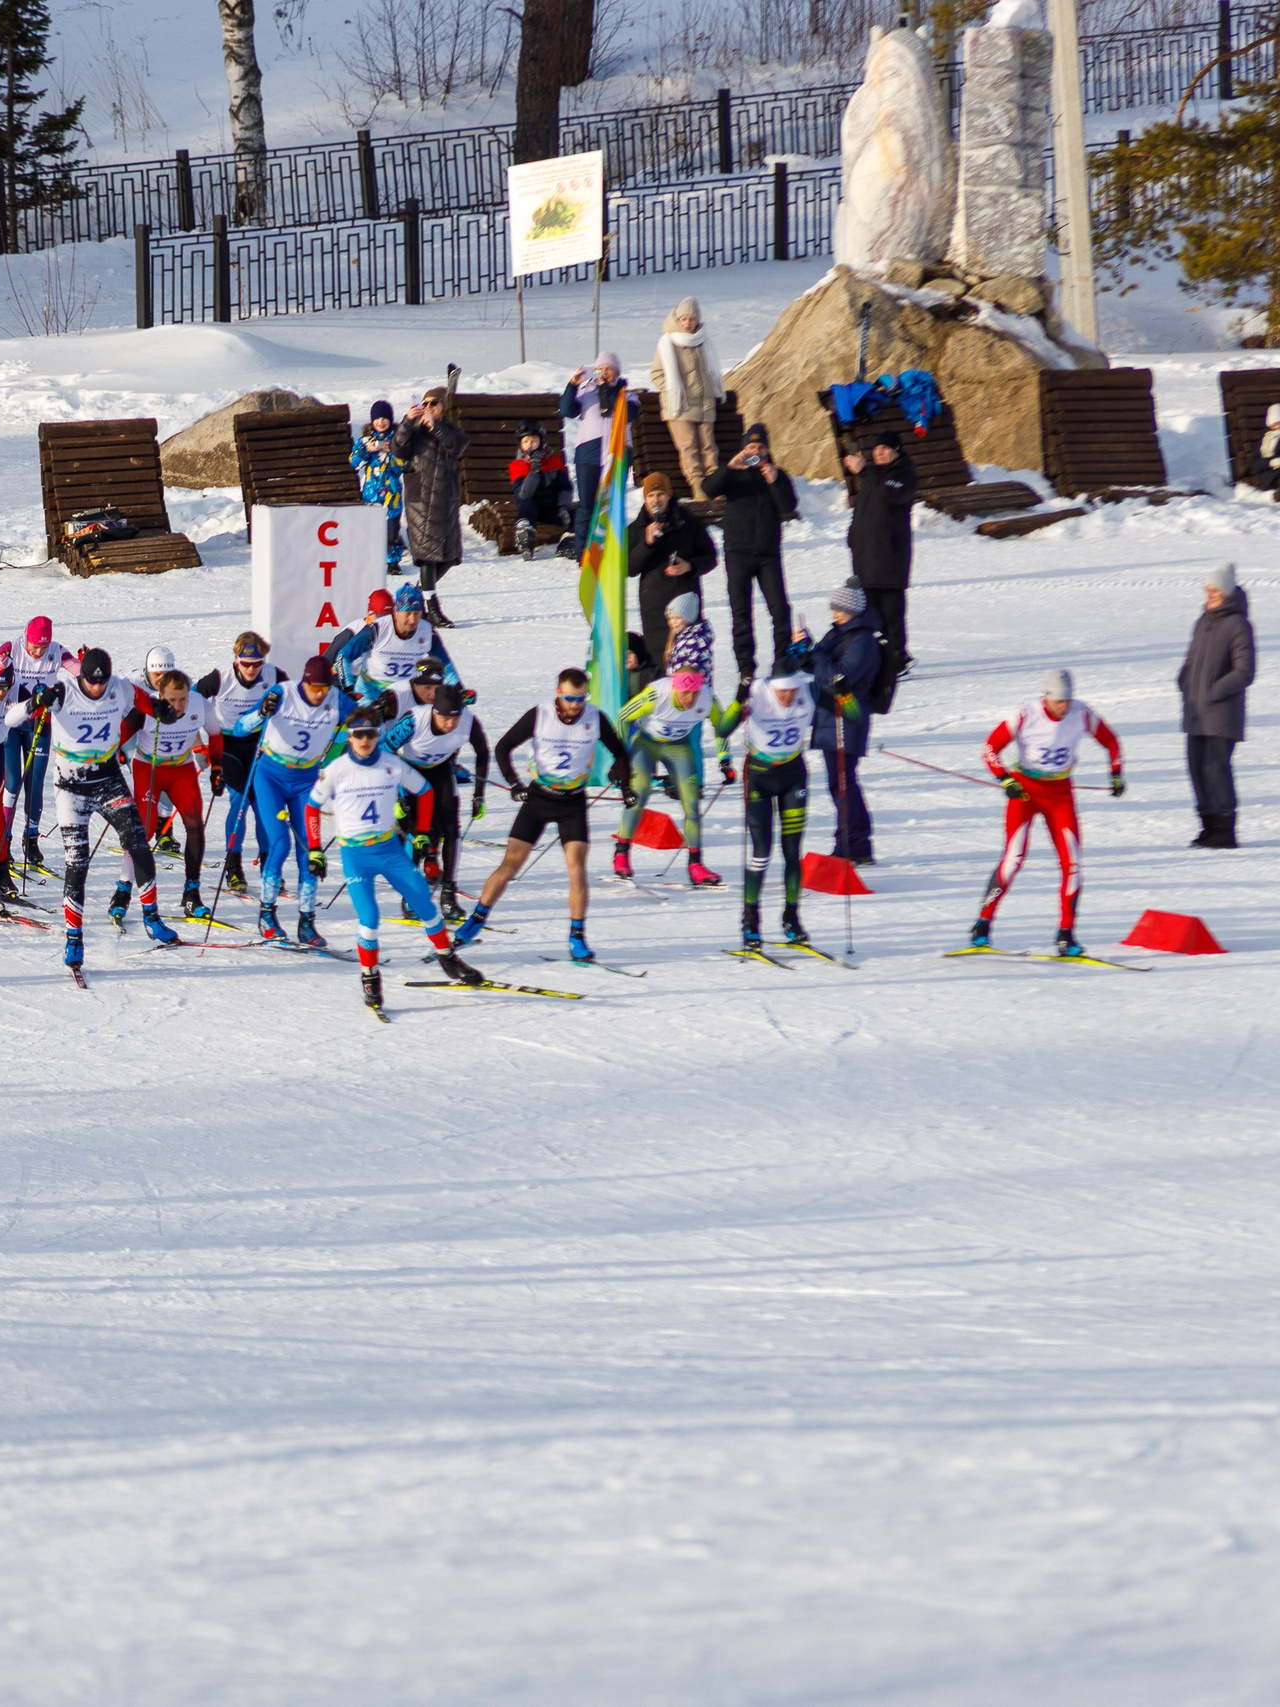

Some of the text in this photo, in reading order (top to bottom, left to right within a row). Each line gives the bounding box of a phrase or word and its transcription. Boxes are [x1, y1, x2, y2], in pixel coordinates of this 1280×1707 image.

[384, 662, 415, 678] 32
[76, 722, 111, 744] 24
[292, 730, 311, 752] 3
[766, 727, 800, 747] 28
[158, 739, 186, 753] 31
[555, 751, 572, 770] 2
[1038, 747, 1070, 766] 38
[361, 800, 380, 825] 4
